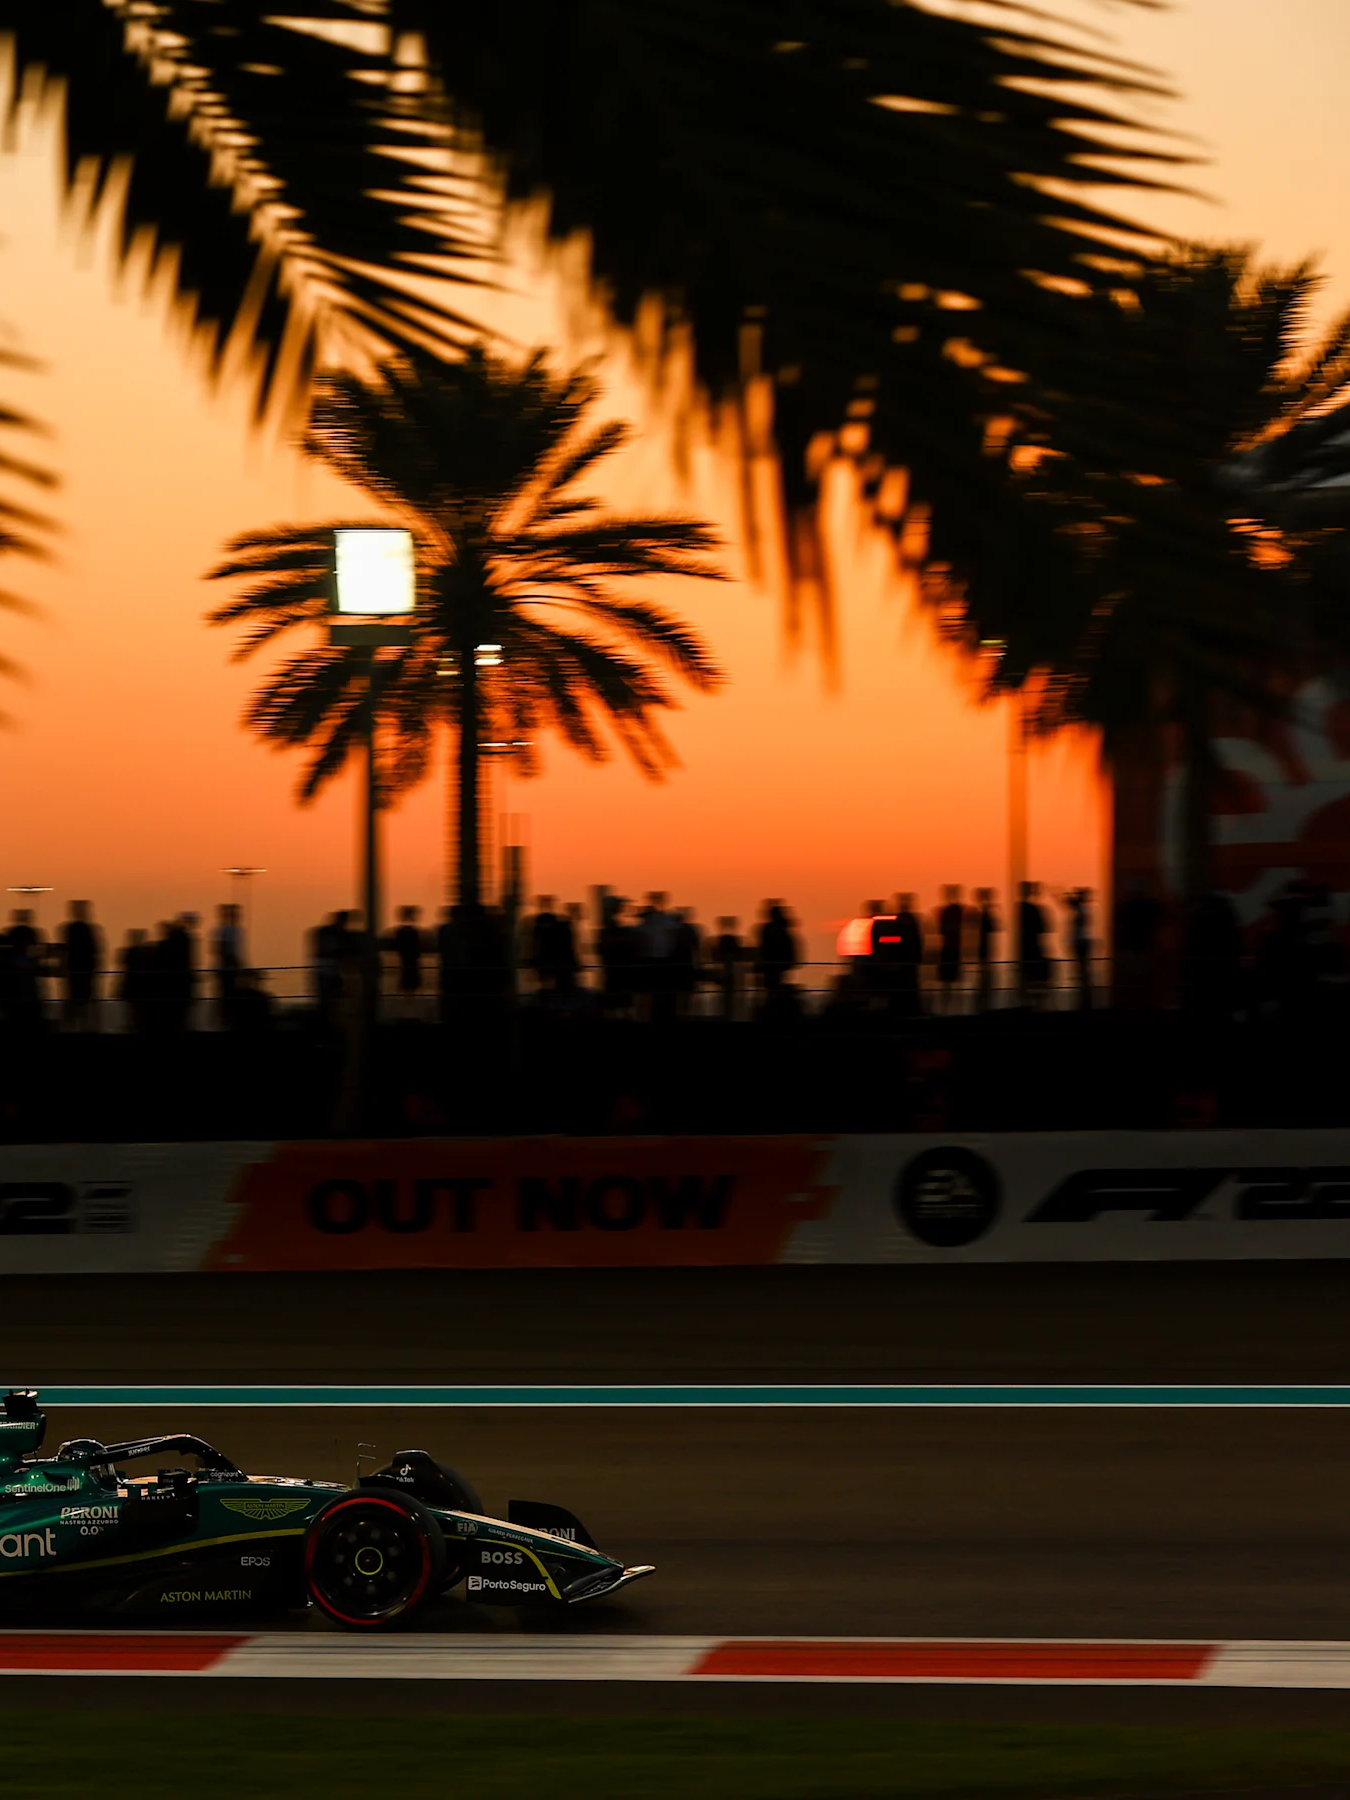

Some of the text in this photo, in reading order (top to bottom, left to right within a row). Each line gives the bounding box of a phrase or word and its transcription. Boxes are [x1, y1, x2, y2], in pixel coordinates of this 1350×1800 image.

[306, 1174, 737, 1234] OUT NOW
[5, 1482, 67, 1494] SentinelOne
[60, 1506, 119, 1519] PERONI
[456, 1521, 477, 1533] FIA
[240, 1556, 270, 1567] EPOS
[480, 1551, 523, 1565] BOSS
[160, 1589, 252, 1603] ASTON MARTIN
